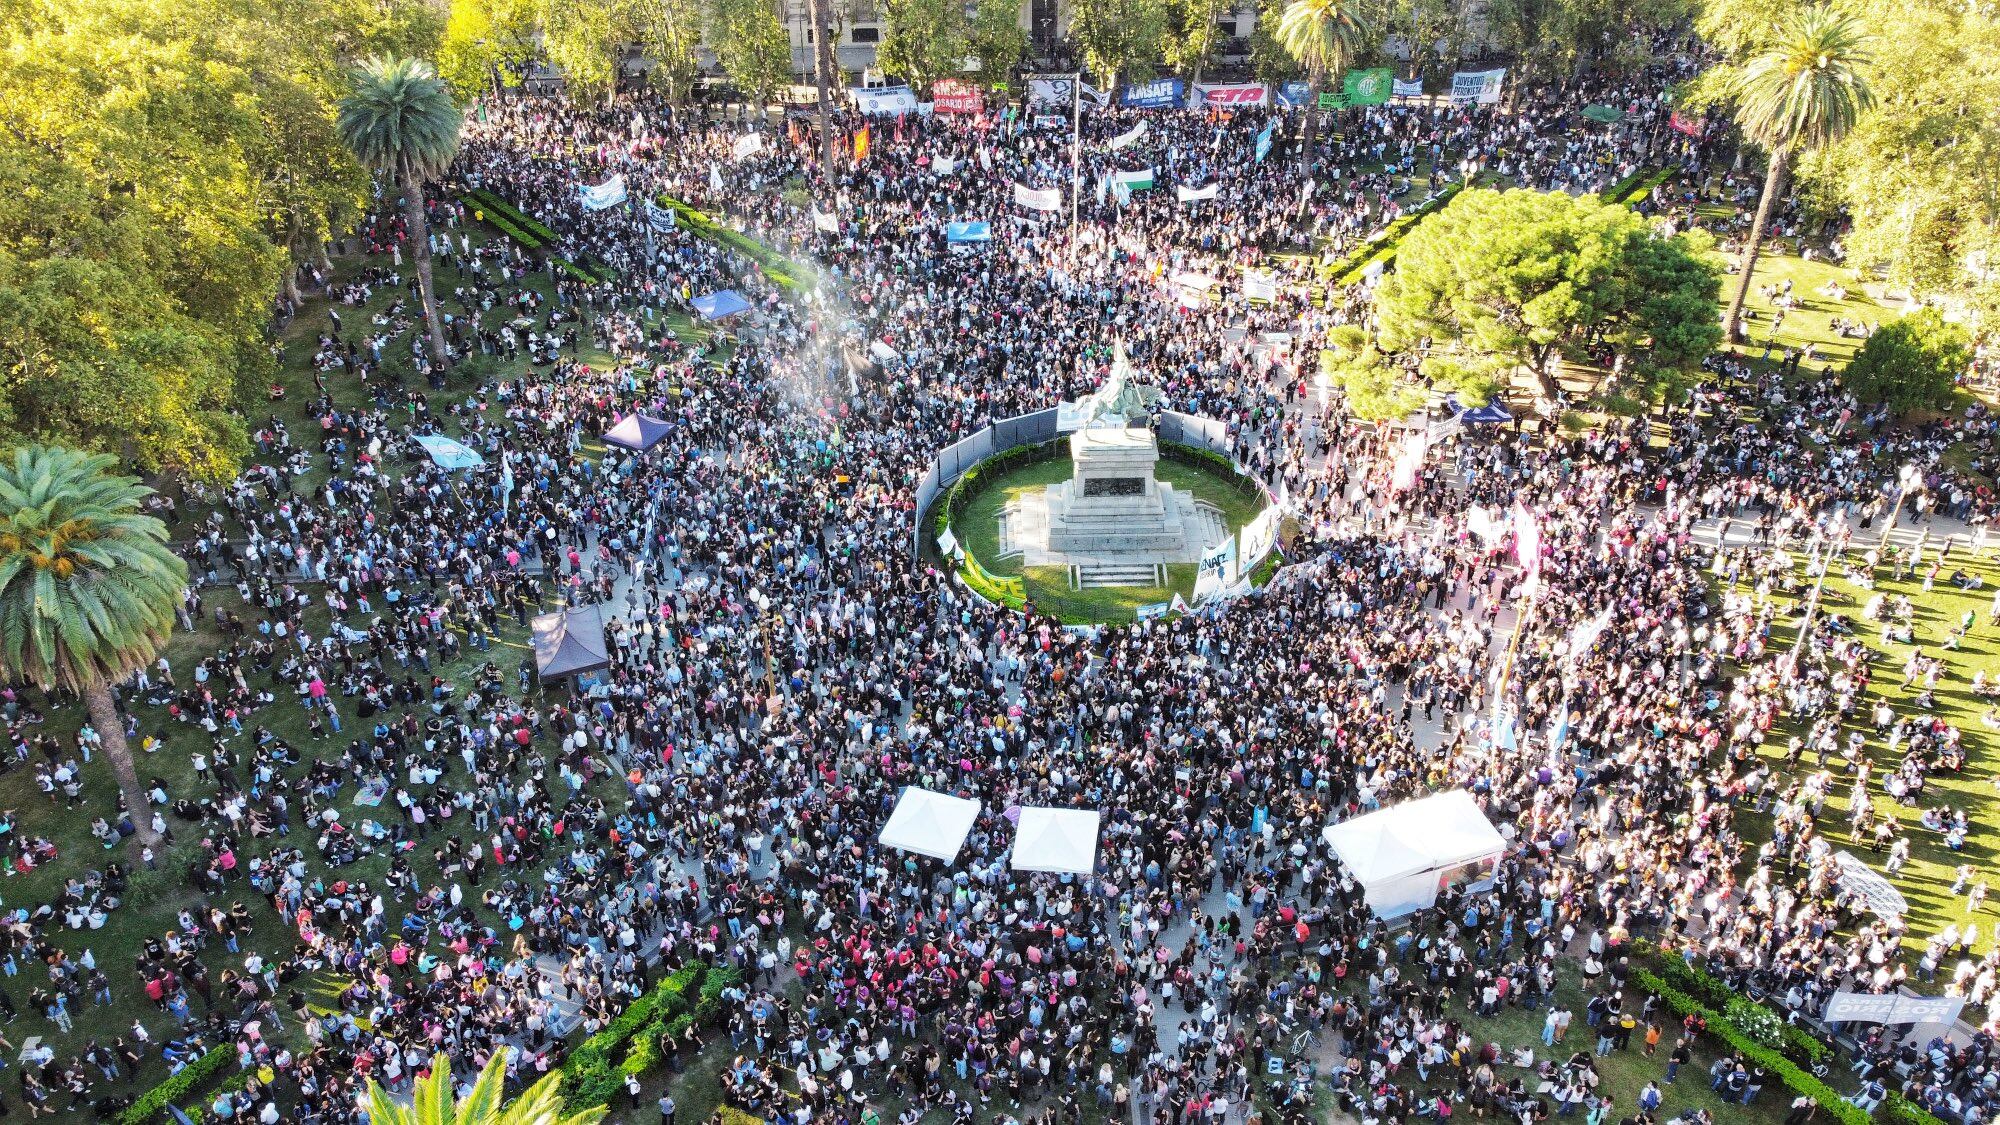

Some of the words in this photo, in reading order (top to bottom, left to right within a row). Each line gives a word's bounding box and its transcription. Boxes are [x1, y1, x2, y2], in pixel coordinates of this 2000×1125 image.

[1455, 75, 1485, 87] JUVENTUD
[1127, 81, 1174, 100] AMSAFE
[1206, 87, 1265, 102] CTA
